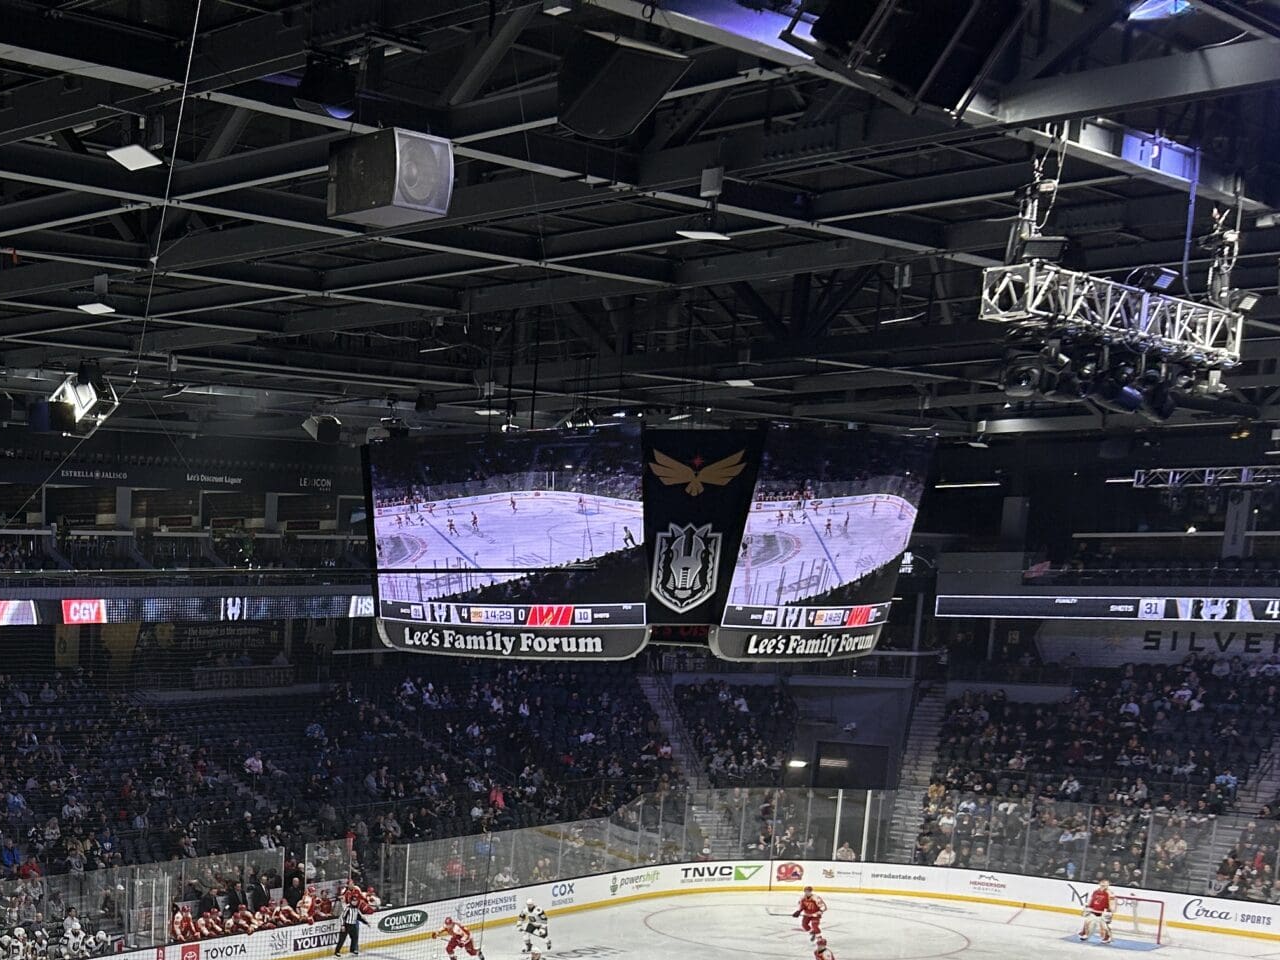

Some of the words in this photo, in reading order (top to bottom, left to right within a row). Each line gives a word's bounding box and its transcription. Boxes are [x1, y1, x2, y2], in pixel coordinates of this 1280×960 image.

[70, 602, 97, 620] CGY
[461, 608, 468, 620] 4
[485, 608, 512, 621] 14:29
[1144, 602, 1160, 615] 31
[404, 627, 440, 648] Lee's
[443, 630, 516, 655] Family
[520, 633, 603, 653] Forum
[747, 634, 786, 655] Lee's
[785, 634, 839, 657] Family
[837, 633, 875, 652] Forum
[681, 866, 733, 879] TNVC
[552, 882, 575, 897] COX
[466, 895, 517, 910] COMPREHENSIVE
[1183, 898, 1232, 920] Circa
[384, 912, 423, 927] COUNTRY
[1240, 913, 1272, 926] SPORTS
[297, 937, 318, 950] YOU
[319, 932, 339, 947] WIN
[204, 943, 247, 960] TOYOTA
